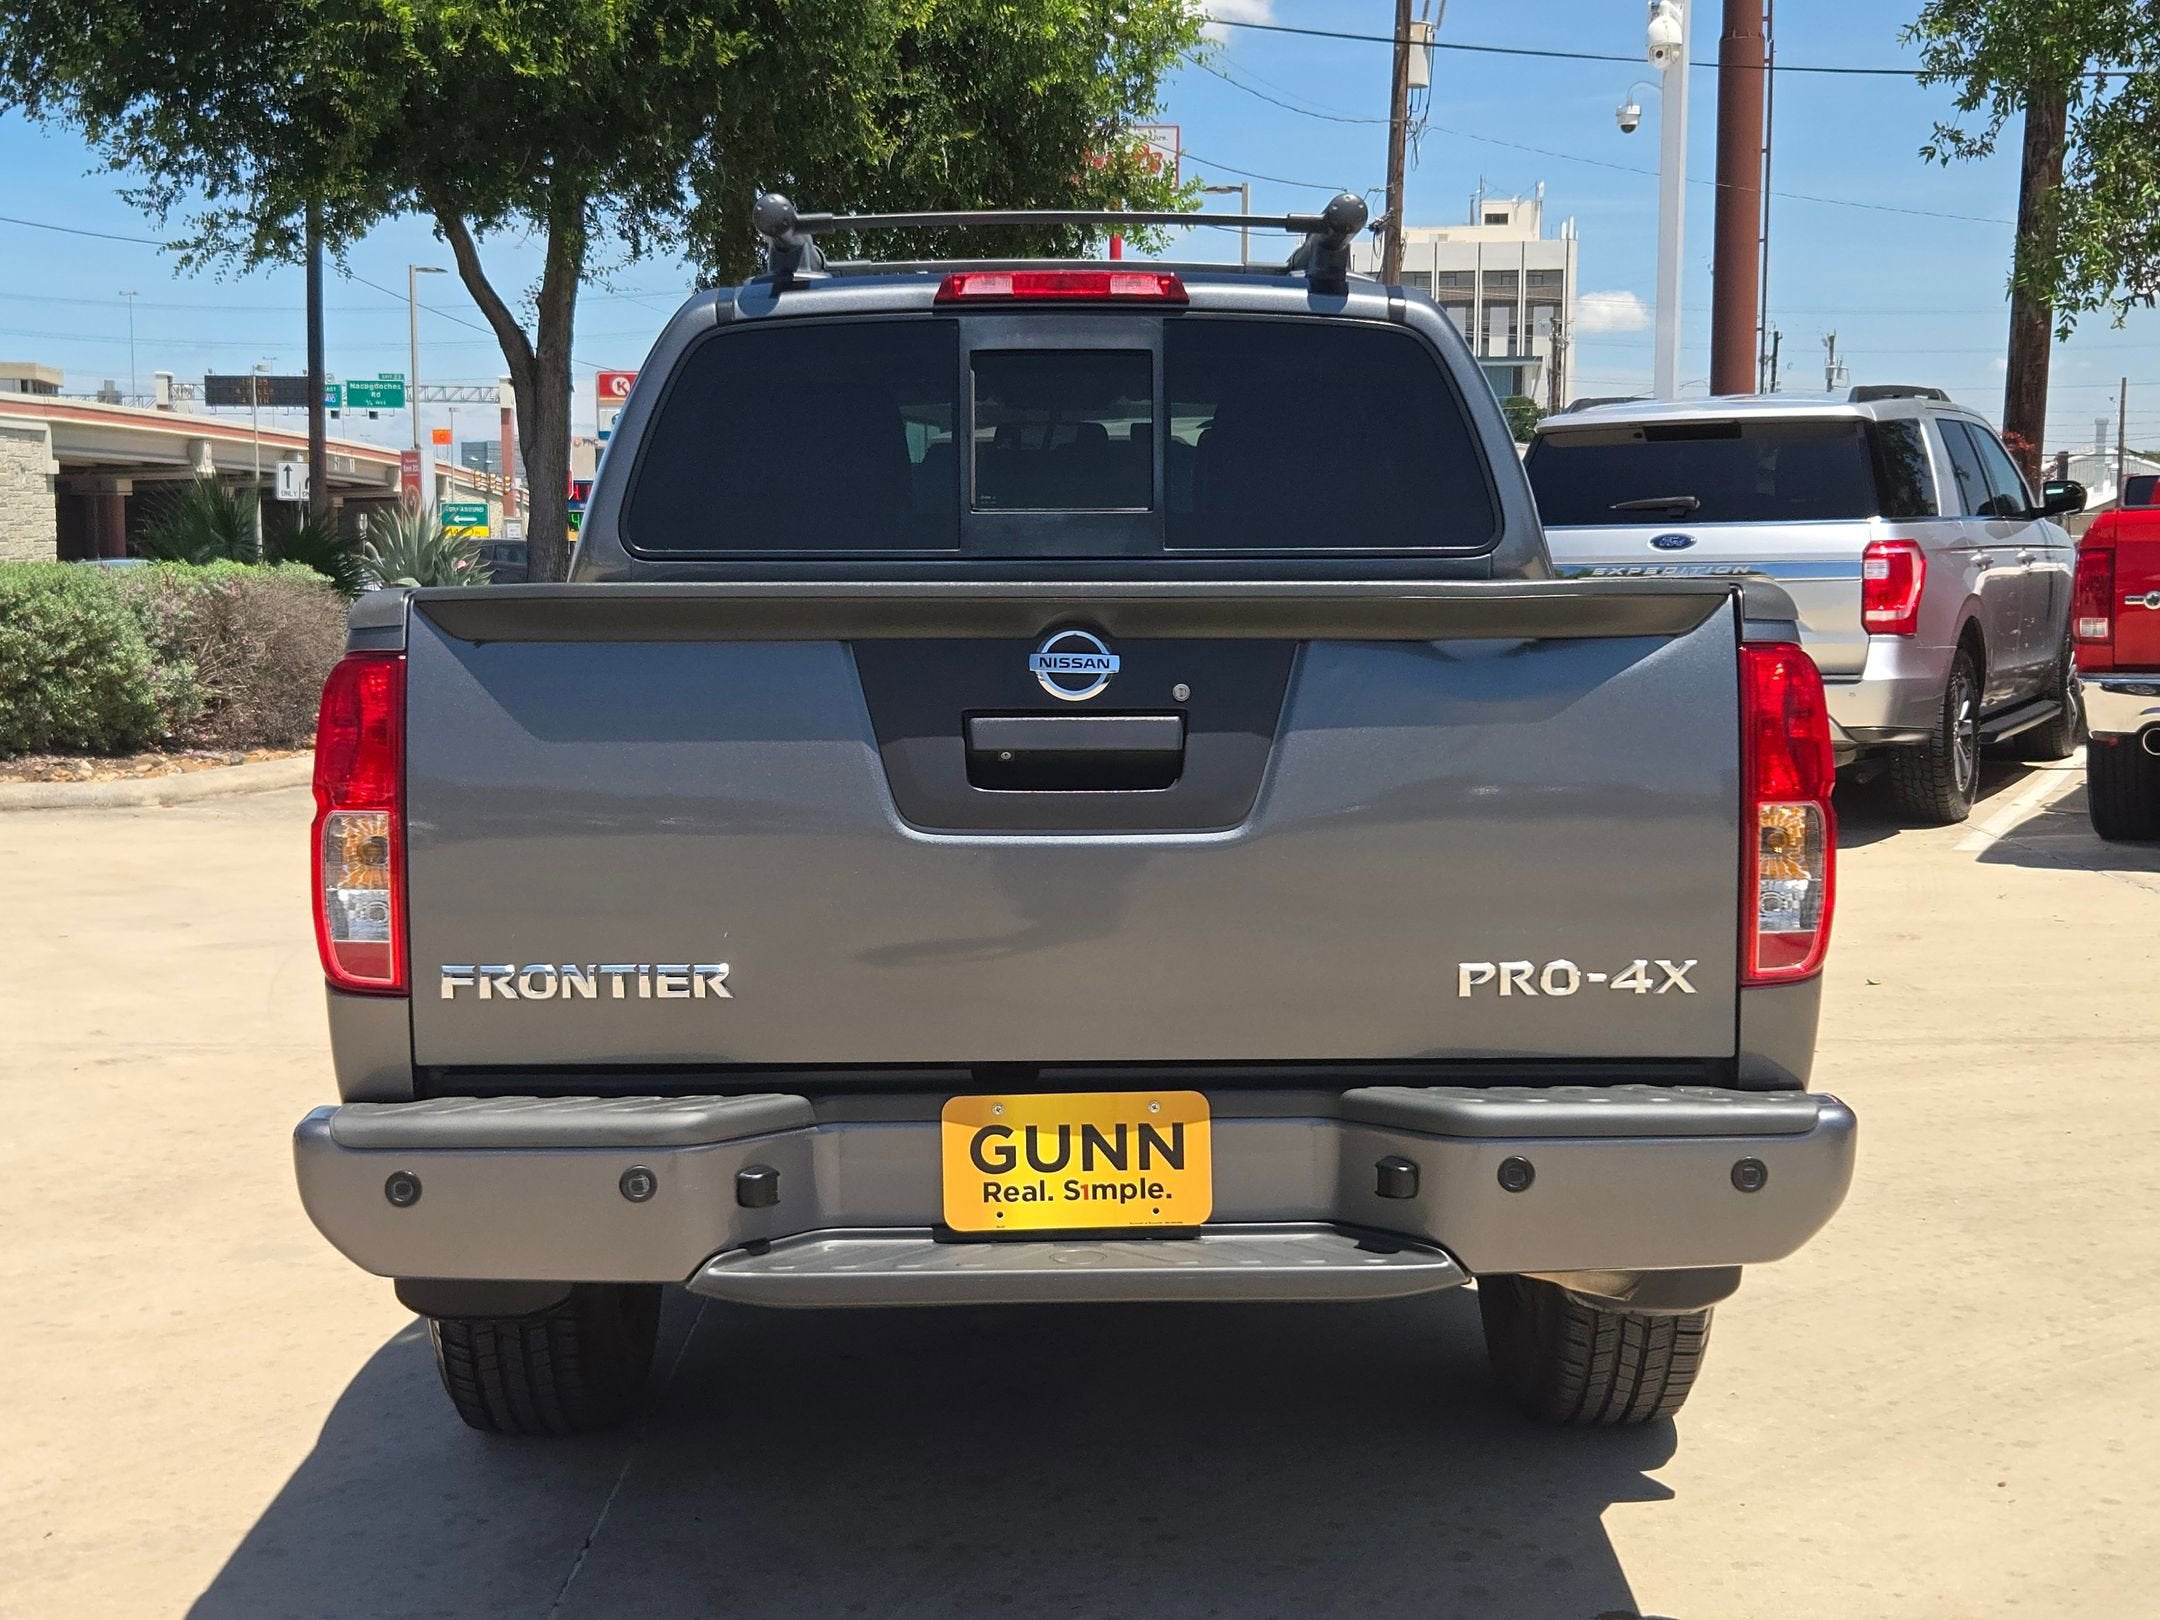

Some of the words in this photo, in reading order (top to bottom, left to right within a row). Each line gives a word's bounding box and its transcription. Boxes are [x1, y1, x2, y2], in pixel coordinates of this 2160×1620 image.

[350, 383, 401, 392] Nacogdoches
[1659, 537, 1685, 547] Ford
[1591, 566, 1750, 576] EXPEDITION
[1039, 657, 1110, 669] NISSAN
[441, 963, 734, 999] FRONTIER
[1458, 959, 1698, 998] PRO-4X
[970, 1122, 1185, 1175] GUNN
[983, 1180, 1054, 1203] Real.
